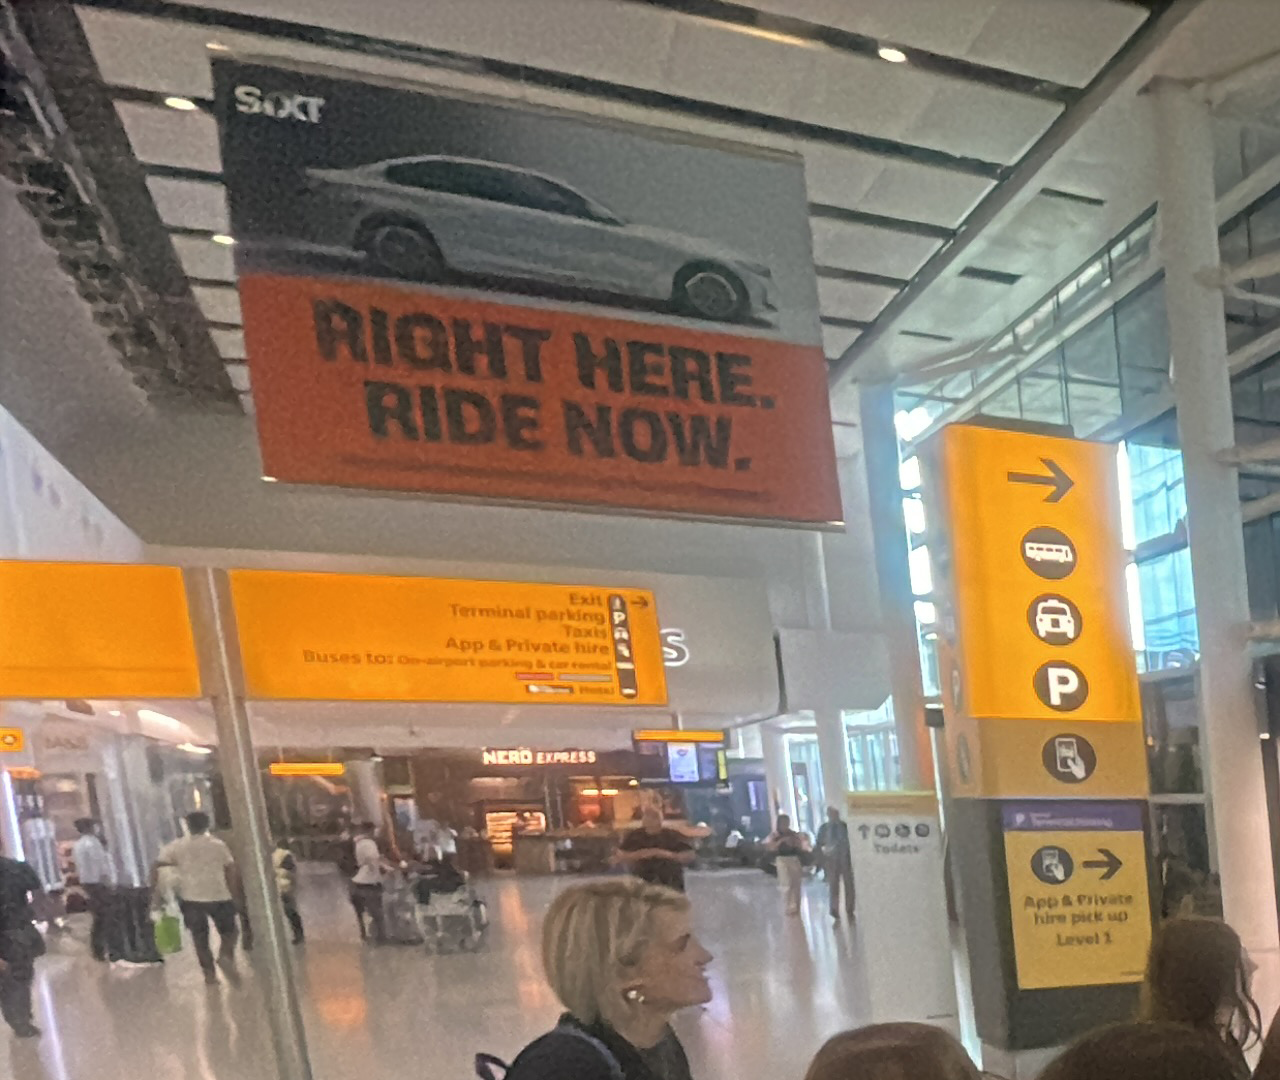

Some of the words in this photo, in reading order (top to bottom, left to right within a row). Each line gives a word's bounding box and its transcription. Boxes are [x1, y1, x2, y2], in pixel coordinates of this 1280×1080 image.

[313, 300, 551, 383] RIGHT
[573, 331, 776, 409] HERE.
[364, 380, 544, 451] RIDE
[561, 401, 752, 471] NOW.
[569, 592, 603, 606] Exit
[449, 603, 532, 620] Terminal
[536, 607, 607, 626] parking
[563, 624, 608, 640] Taxis
[446, 636, 485, 654] App
[488, 639, 502, 652] &
[506, 639, 571, 654] Private
[575, 642, 610, 656] hire
[303, 650, 362, 665] Buses
[366, 652, 394, 665] to:
[483, 750, 533, 765] NERO
[536, 750, 597, 765] EXPRESS
[1024, 895, 1059, 911] App
[1077, 894, 1133, 907] Private
[1034, 911, 1067, 926] hire
[1071, 910, 1104, 926] pick
[1056, 933, 1100, 947] Level
